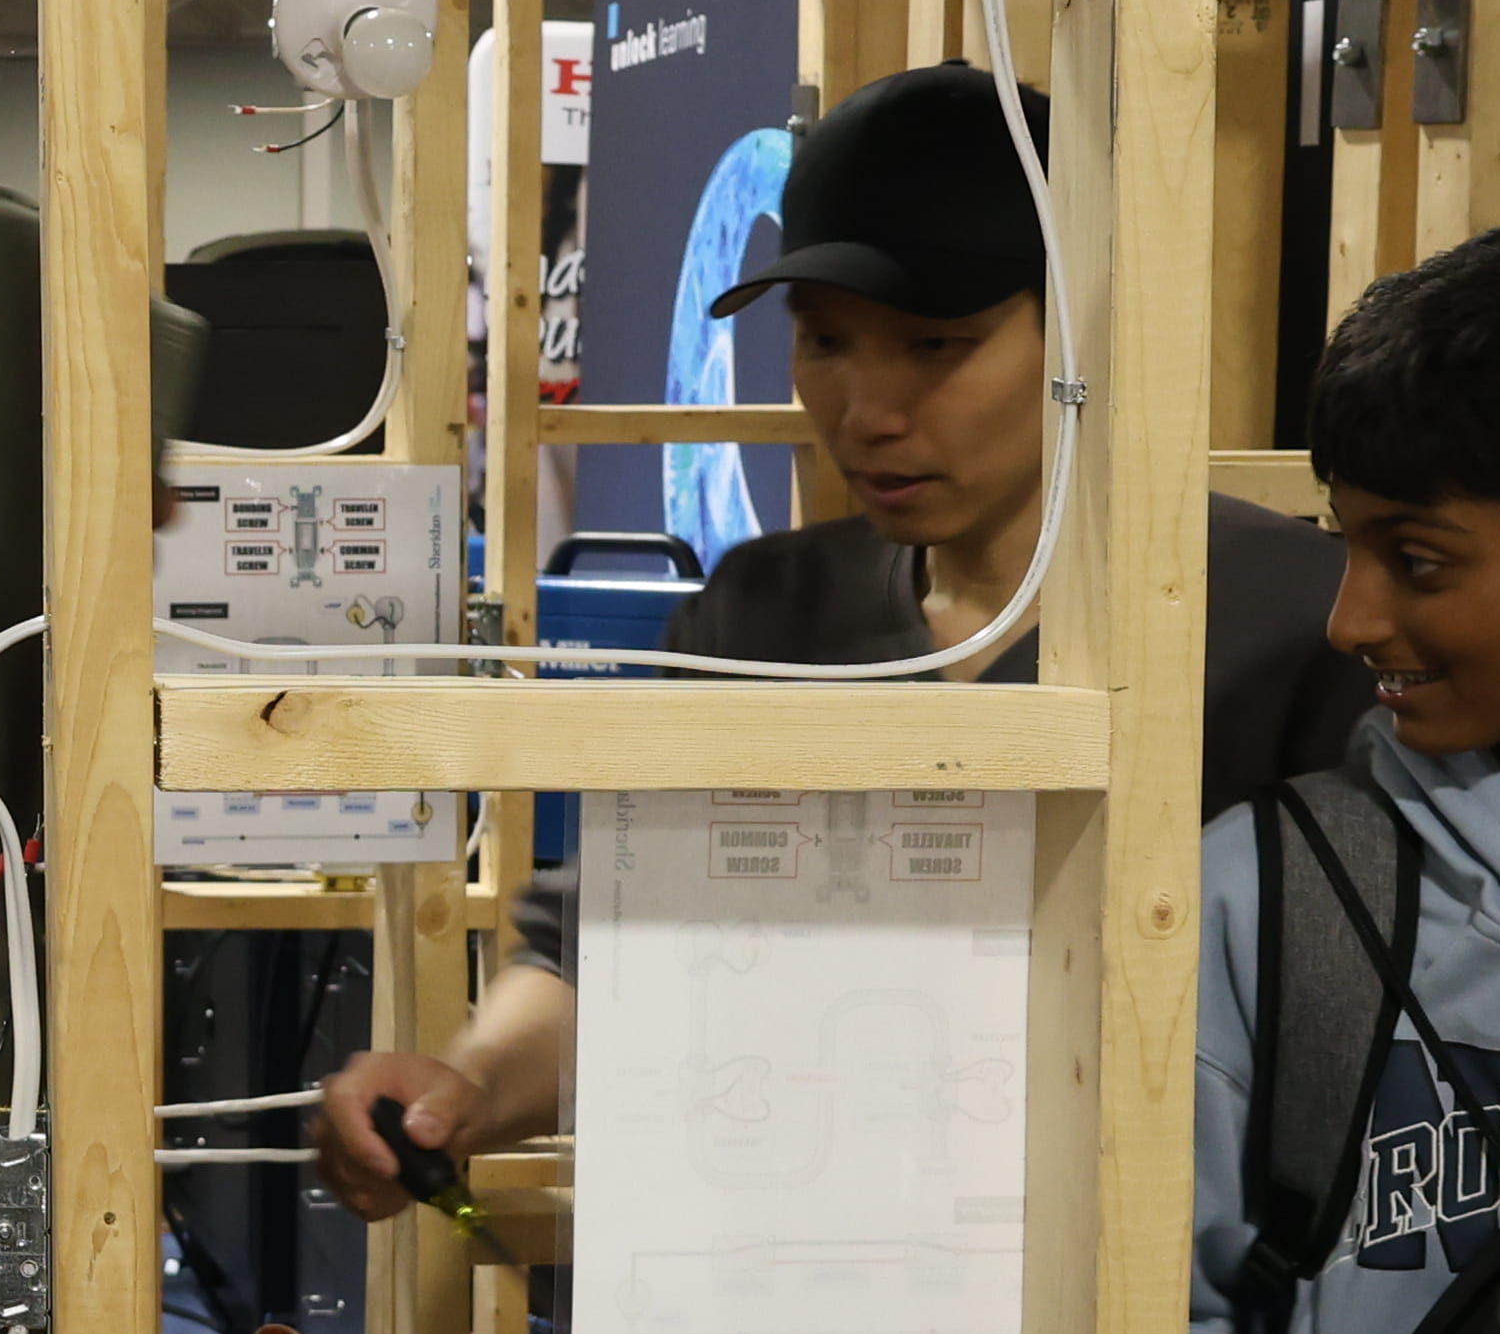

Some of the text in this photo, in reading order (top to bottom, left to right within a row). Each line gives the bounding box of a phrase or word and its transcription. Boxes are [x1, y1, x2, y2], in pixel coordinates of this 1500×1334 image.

[610, 9, 707, 71] unlock learning
[428, 514, 441, 569] Sheridan
